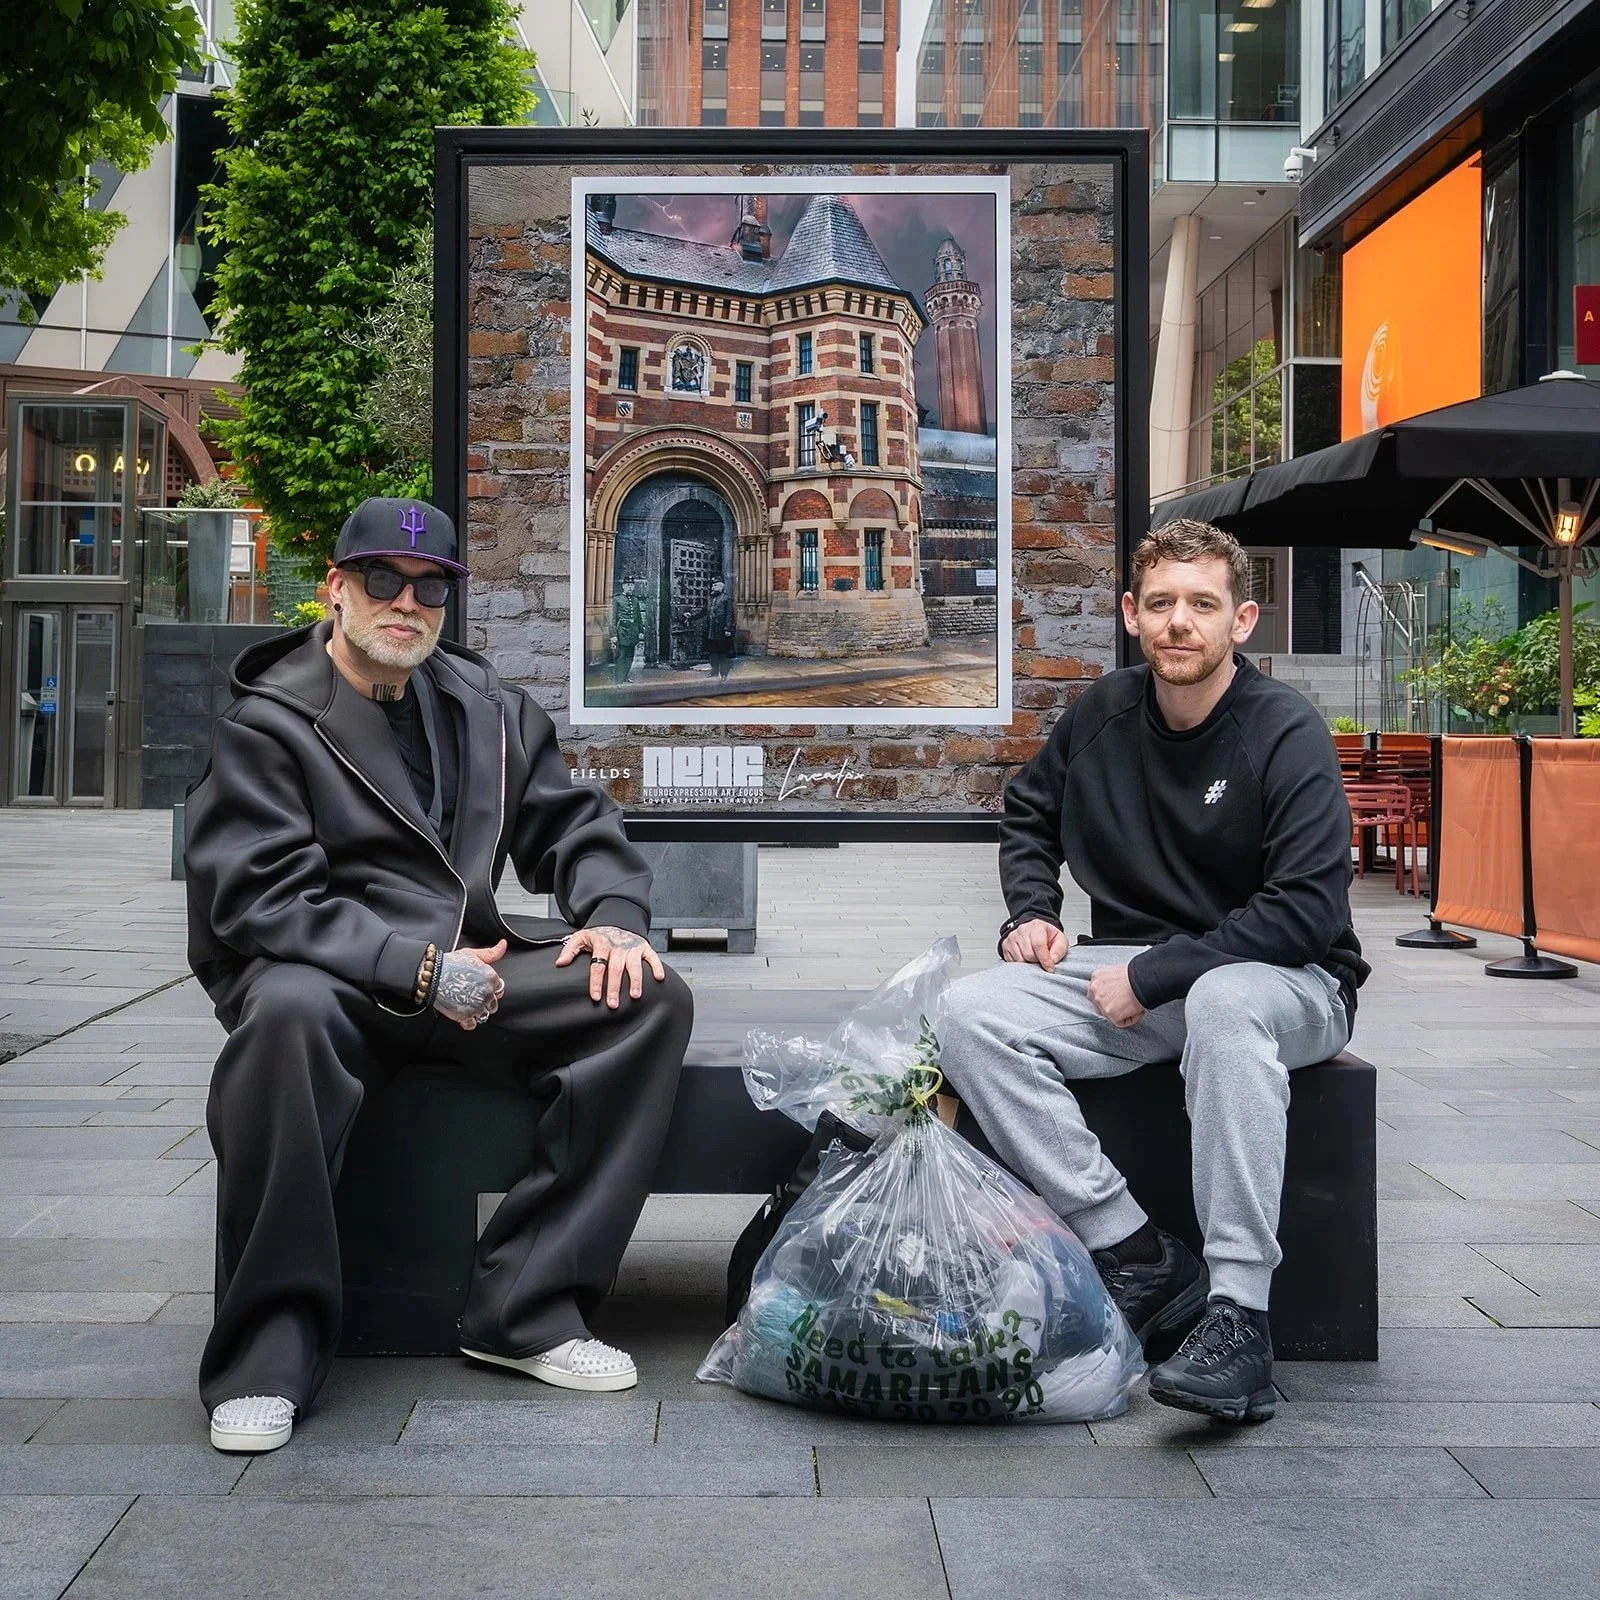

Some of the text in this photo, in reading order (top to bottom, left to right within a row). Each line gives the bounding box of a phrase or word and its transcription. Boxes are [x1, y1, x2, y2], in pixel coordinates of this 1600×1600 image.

[643, 788, 764, 797] NEUROEXPRESSION ART FOCUS
[788, 1303, 1021, 1369] Need to talk?
[785, 1342, 1033, 1403] SAMARITANS
[1002, 1380, 1044, 1412] 90
